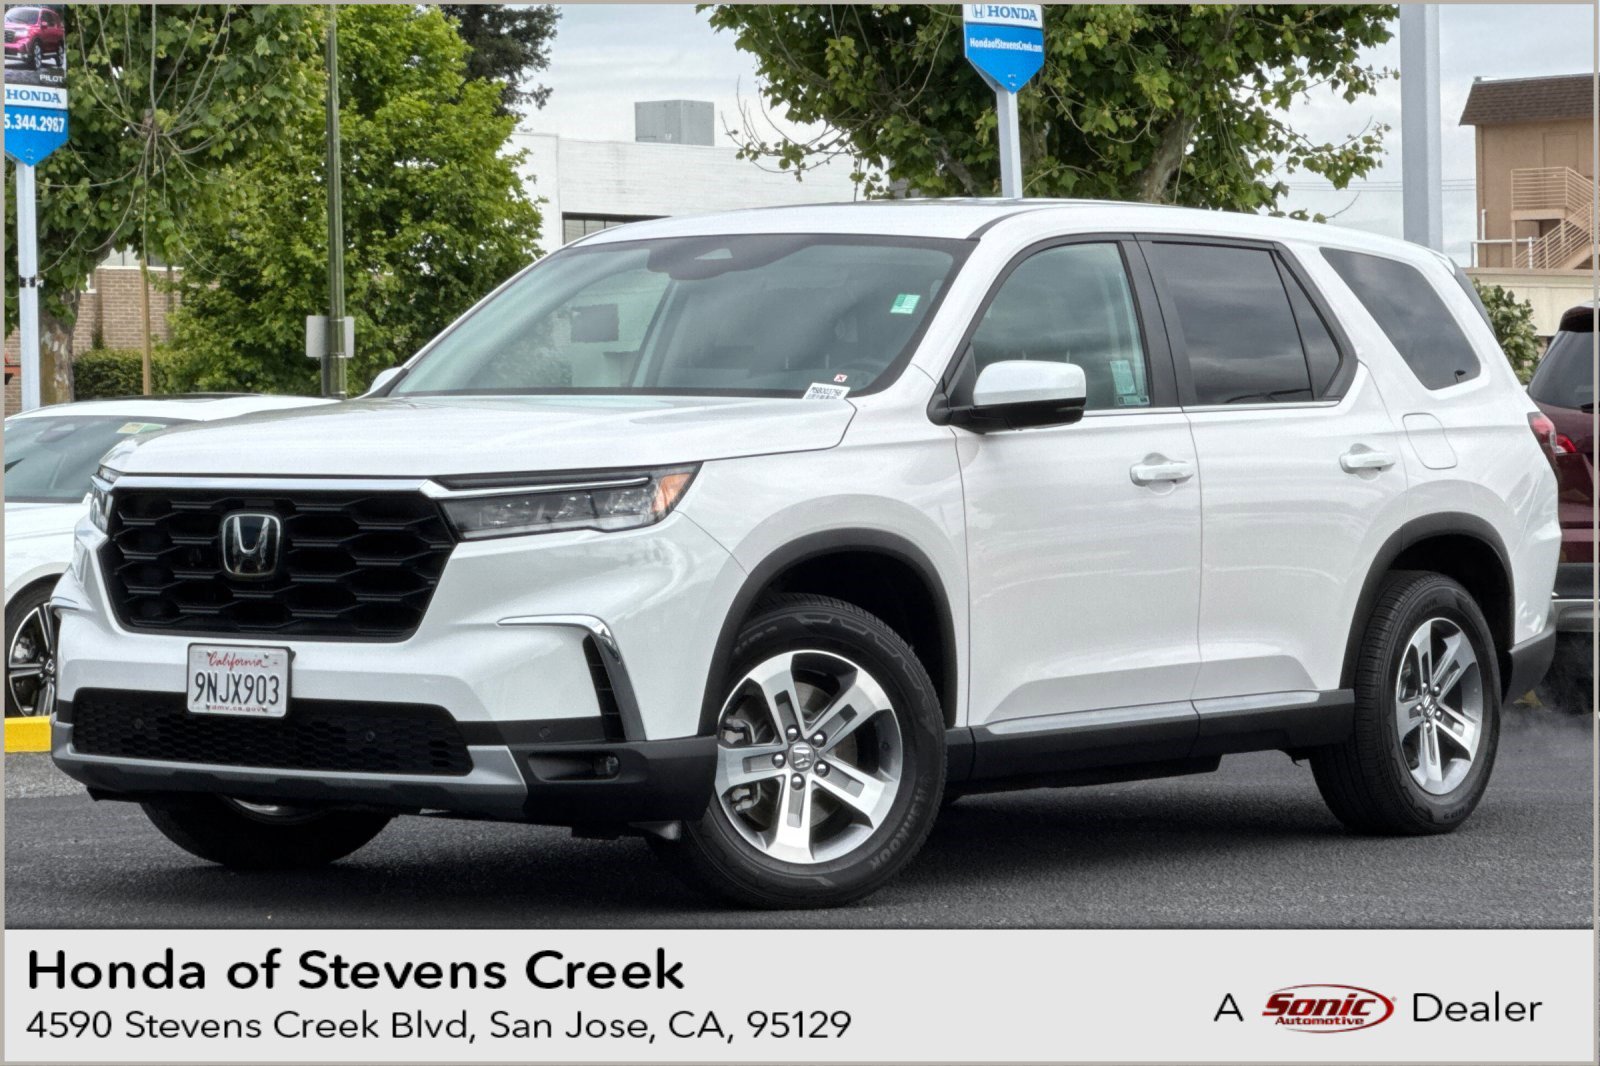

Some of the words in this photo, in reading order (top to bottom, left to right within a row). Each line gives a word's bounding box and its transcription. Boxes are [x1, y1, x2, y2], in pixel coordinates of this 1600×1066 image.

[987, 5, 1038, 21] HONDA
[969, 37, 1043, 53] HondaofStevensCreek.com
[39, 74, 64, 83] PILOT
[6, 88, 62, 104] HONDA
[208, 651, 268, 671] California
[194, 672, 280, 705] 9NJX903
